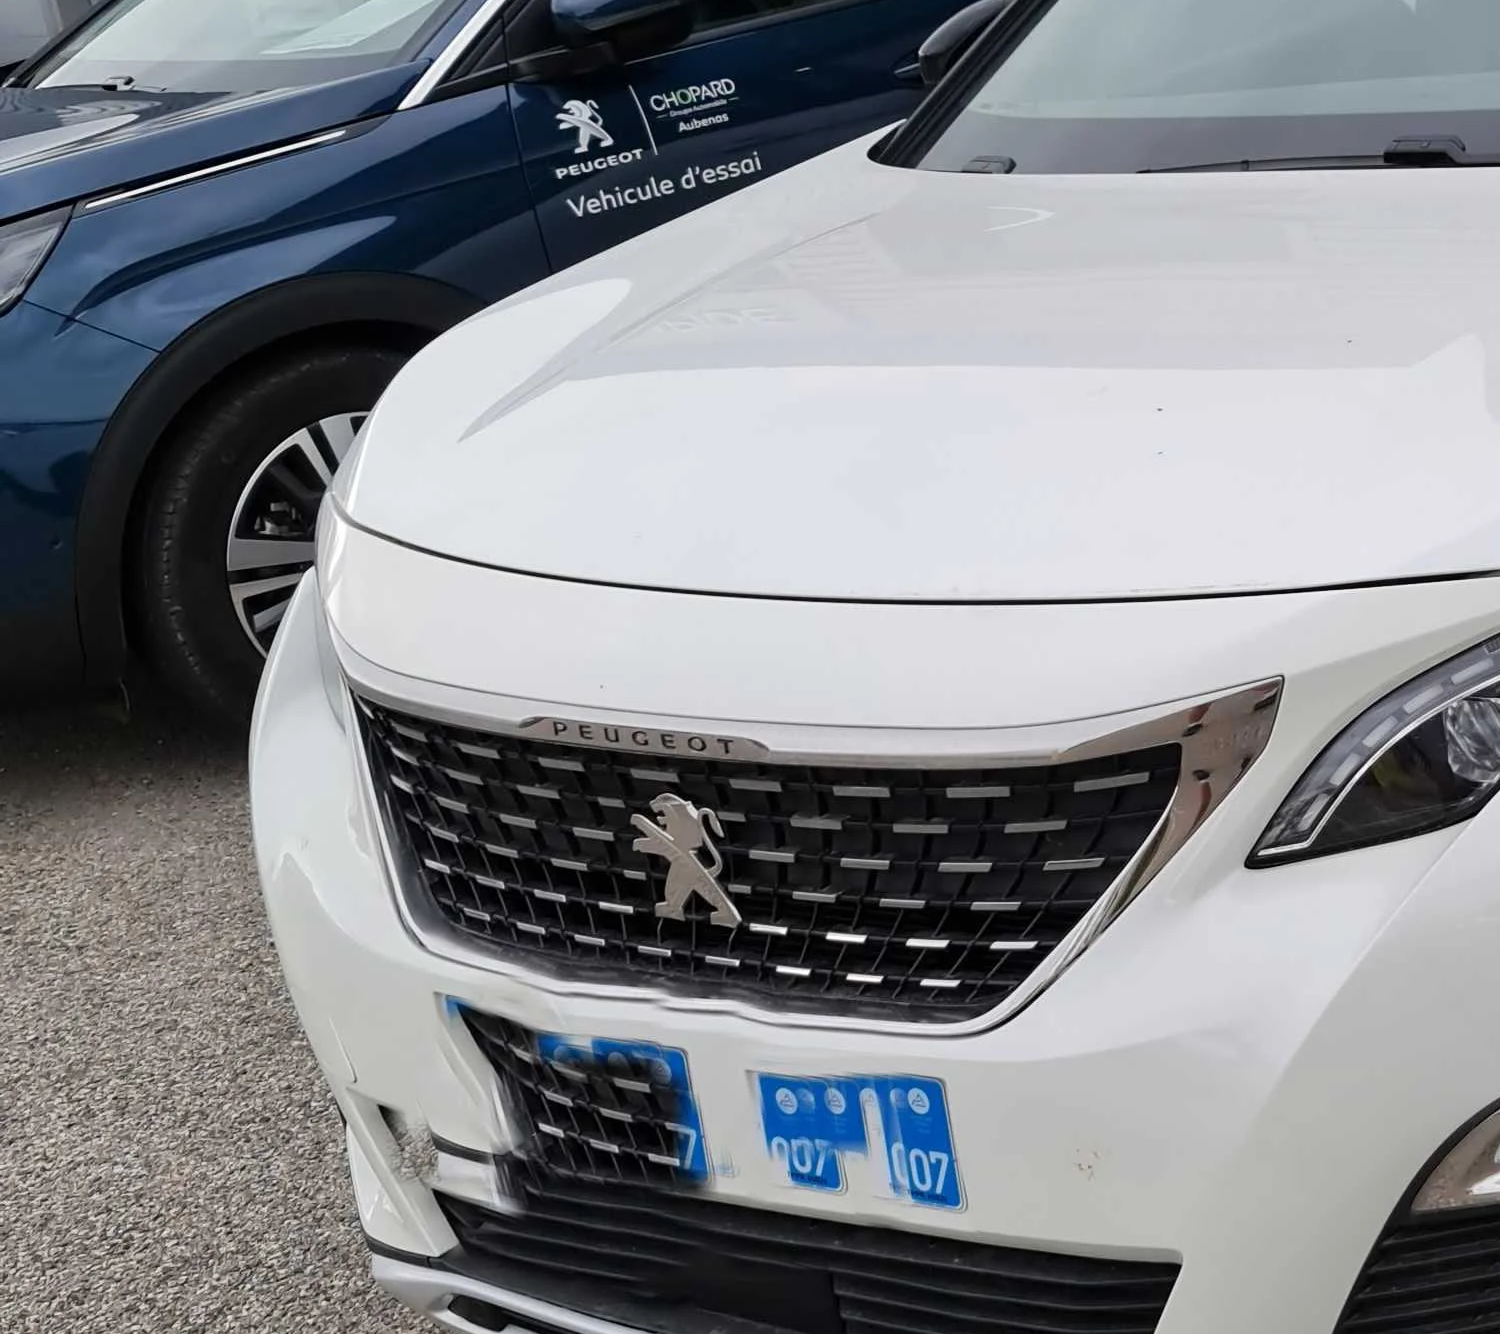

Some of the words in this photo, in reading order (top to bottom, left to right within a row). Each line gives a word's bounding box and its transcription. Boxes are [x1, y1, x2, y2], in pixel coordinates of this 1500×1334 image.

[650, 78, 736, 112] CHOPARD
[555, 149, 644, 180] PEUGEOT
[566, 177, 675, 218] Vehicule
[553, 721, 734, 755] PEUGEOT
